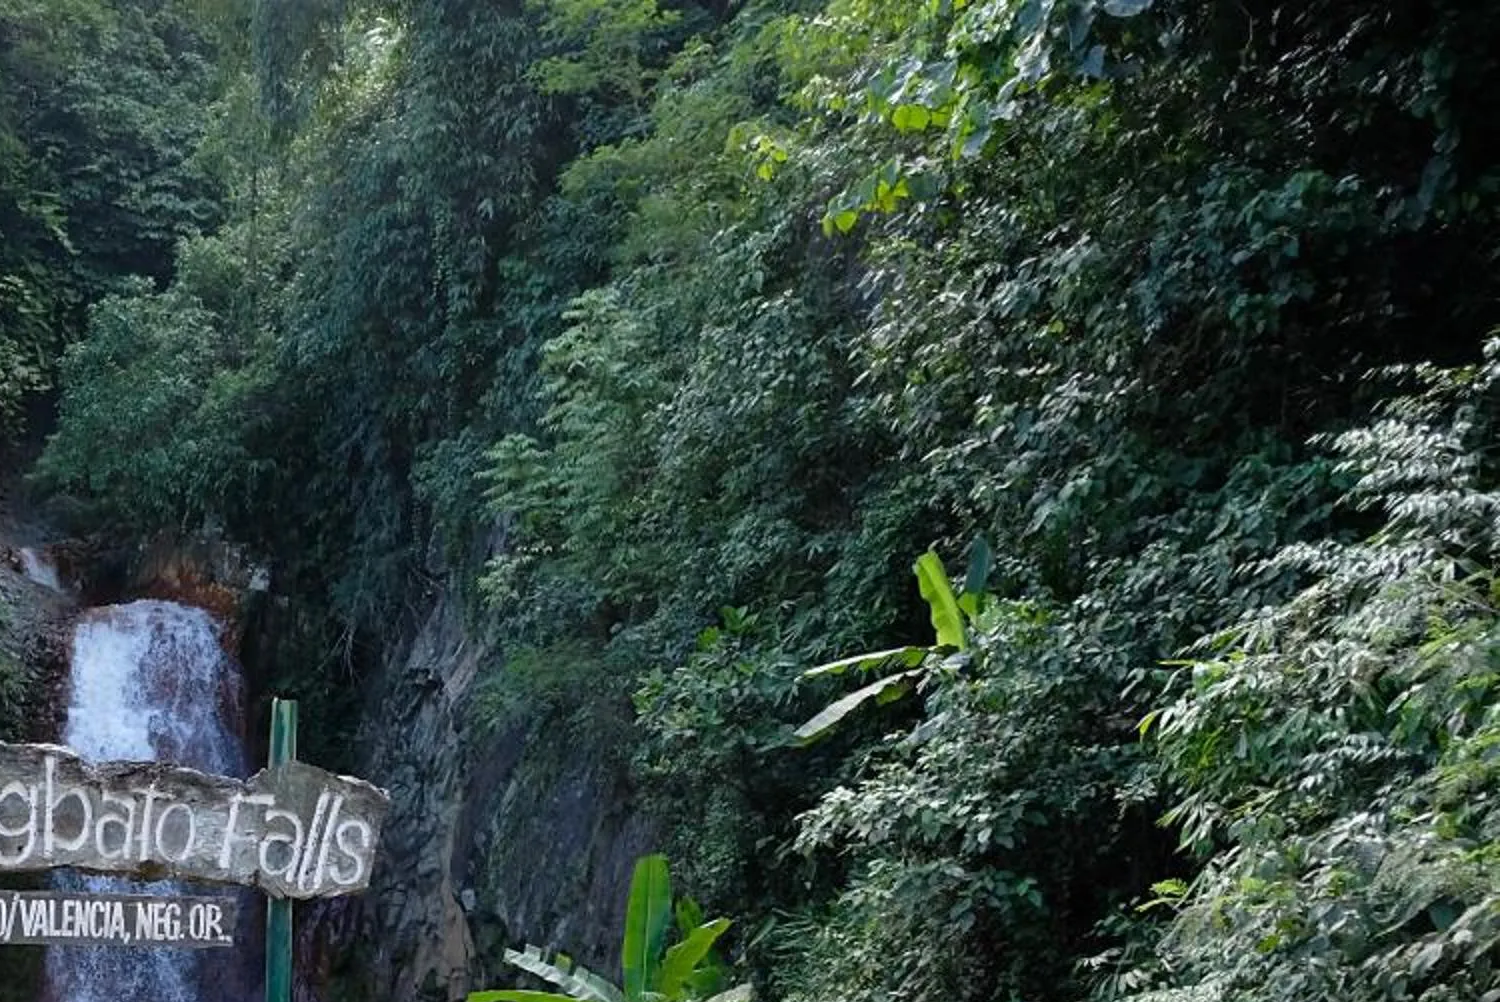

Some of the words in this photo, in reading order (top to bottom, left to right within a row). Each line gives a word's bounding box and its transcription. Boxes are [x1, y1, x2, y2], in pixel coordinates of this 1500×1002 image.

[219, 786, 372, 893] Falls
[135, 902, 185, 941] NEG.
[189, 903, 233, 944] OR.
